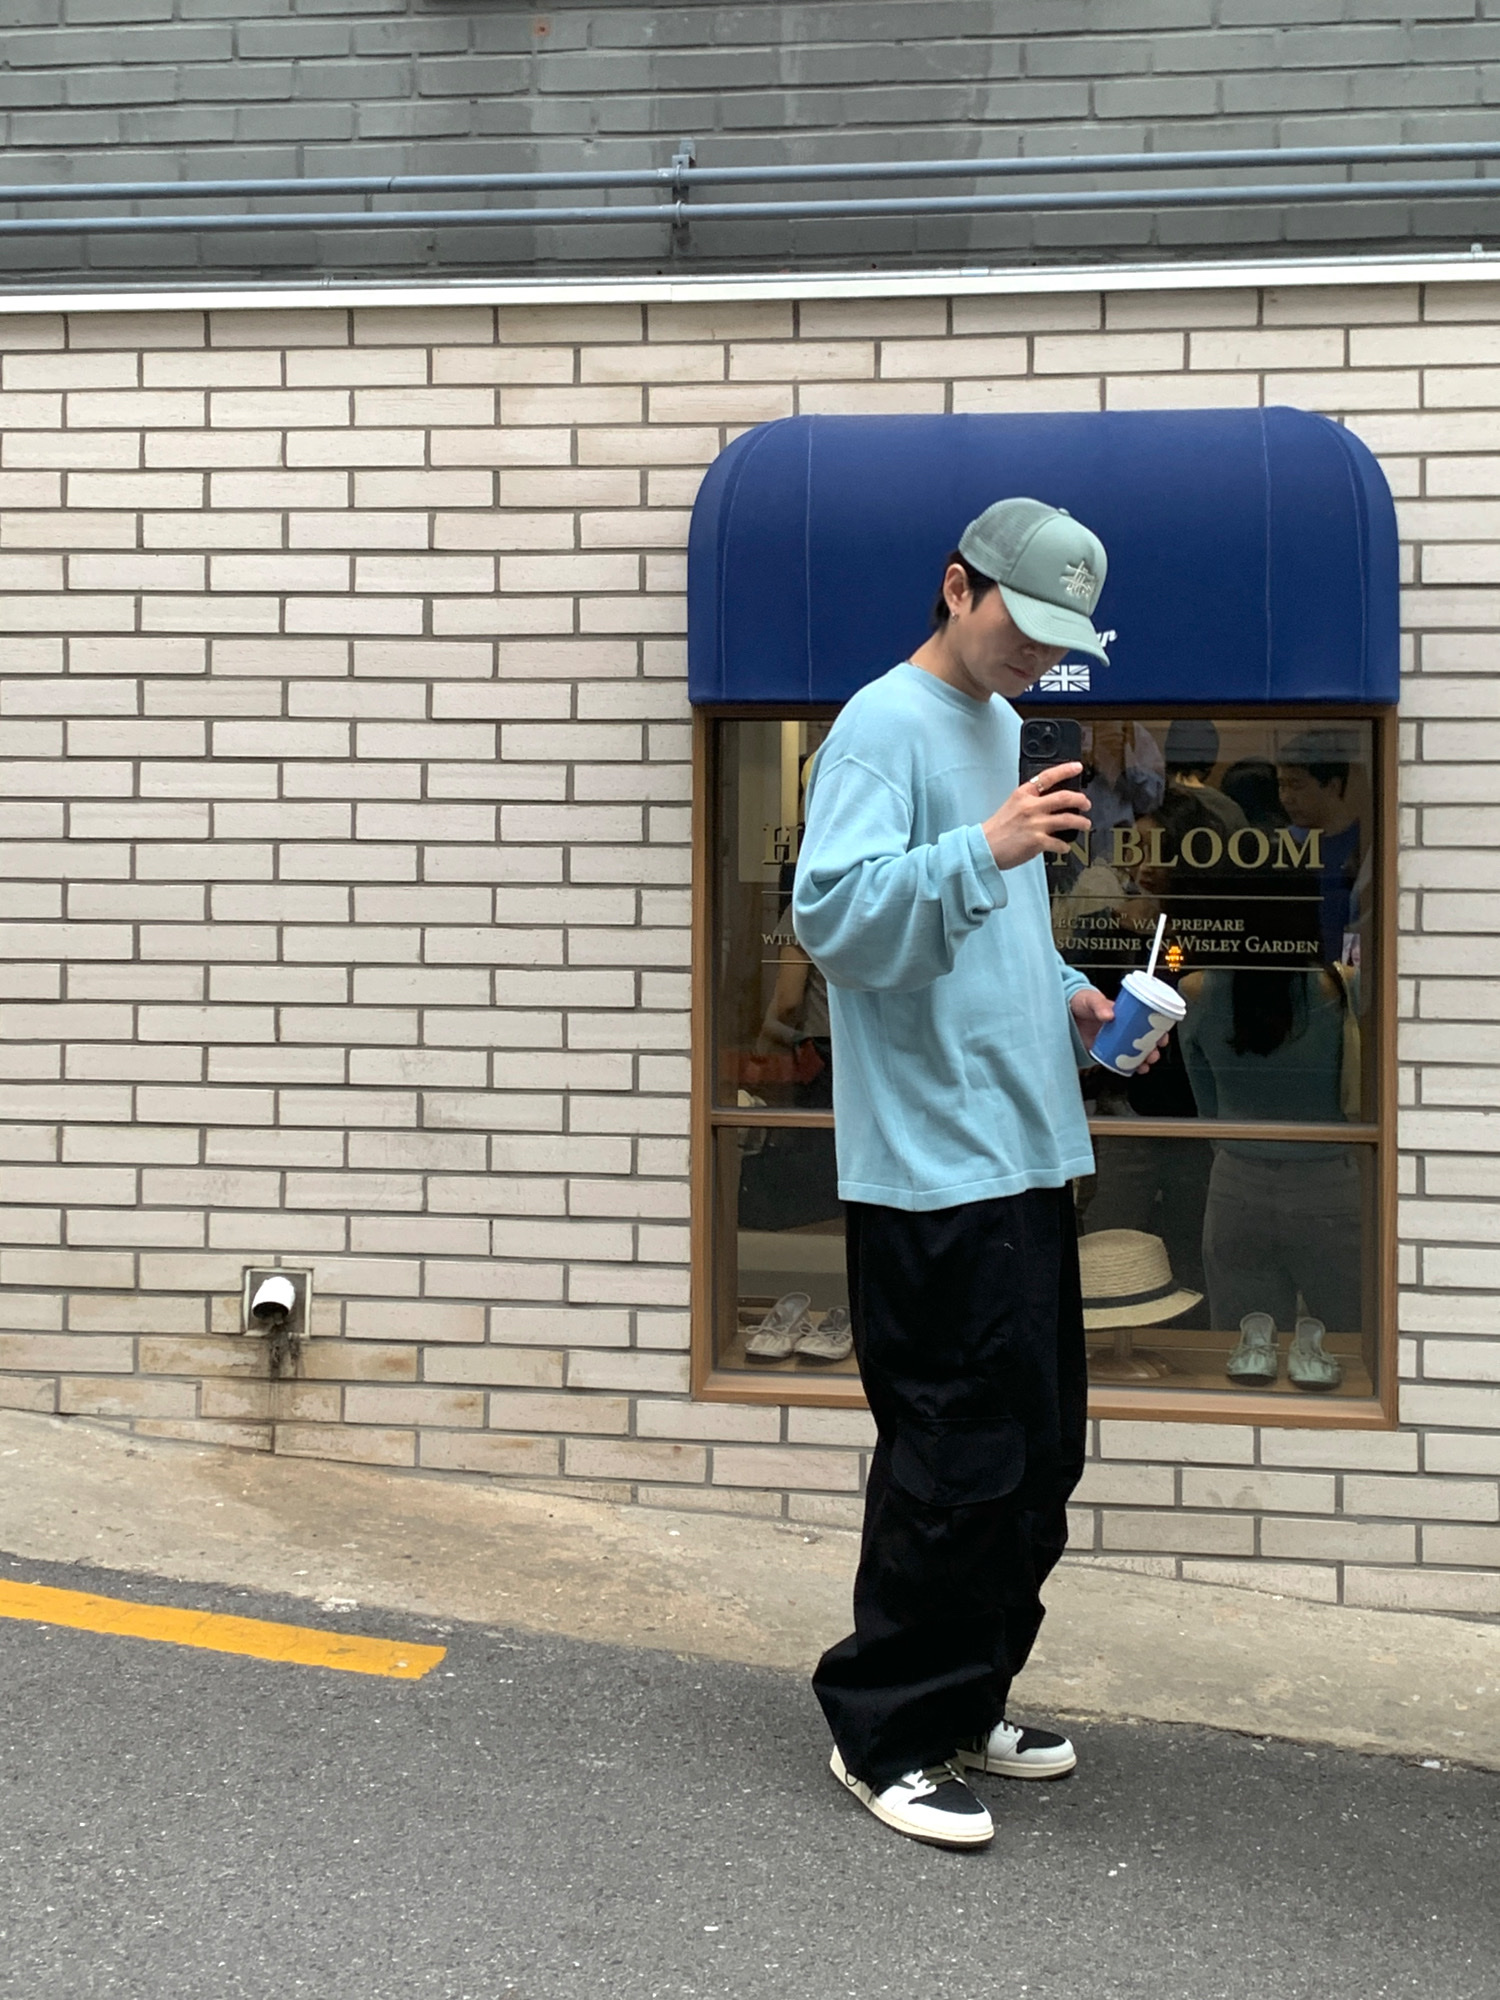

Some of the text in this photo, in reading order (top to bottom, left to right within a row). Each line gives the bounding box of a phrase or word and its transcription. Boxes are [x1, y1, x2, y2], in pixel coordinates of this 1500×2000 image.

[1111, 827, 1324, 868] BLOOM
[1132, 919, 1160, 931] WA
[1172, 919, 1245, 932] PREPARE
[762, 934, 800, 945] WIT
[1057, 938, 1142, 951] SUNSHINE
[1245, 936, 1320, 954] GARDEN
